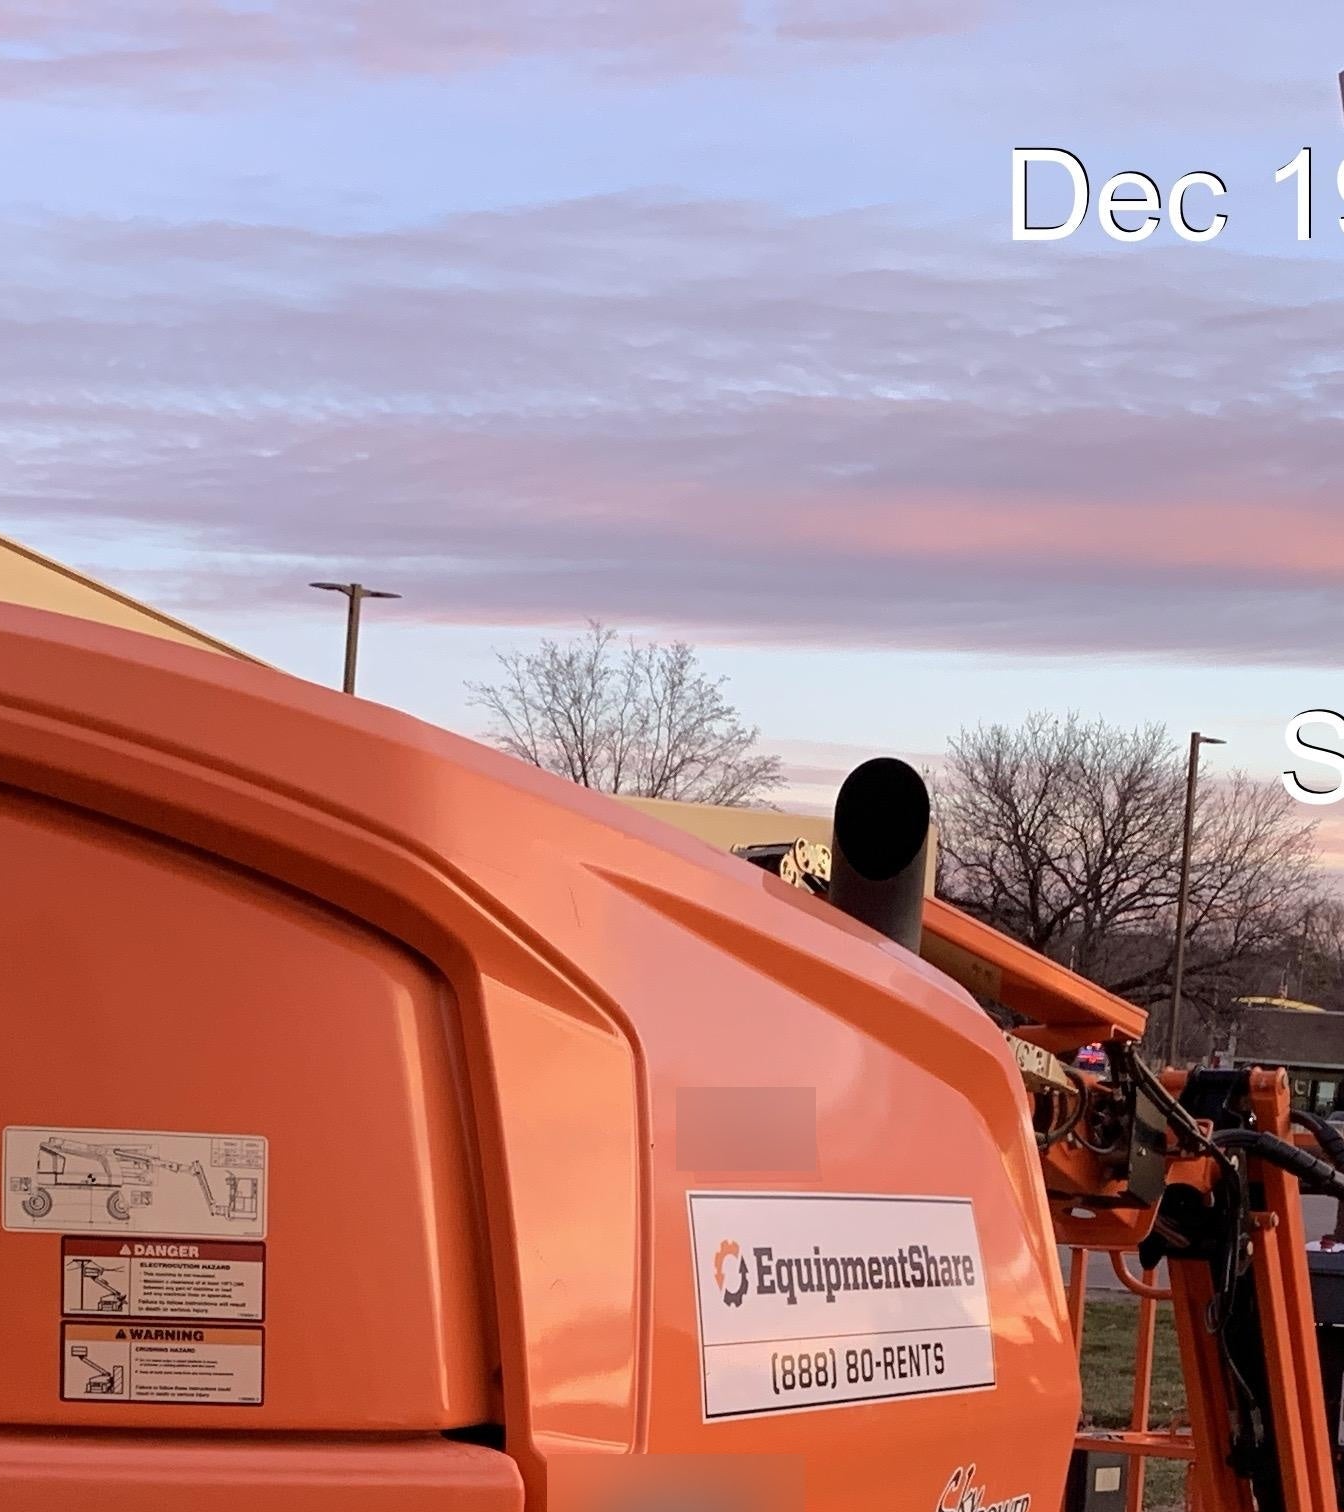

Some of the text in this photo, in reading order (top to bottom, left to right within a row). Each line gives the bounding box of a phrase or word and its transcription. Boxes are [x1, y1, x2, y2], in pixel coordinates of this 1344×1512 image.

[133, 1244, 200, 1259] DANGER
[753, 1244, 975, 1305] EquipmentShare
[129, 1329, 205, 1342] WARNING
[771, 1342, 945, 1395] (888) 80-RENTS
